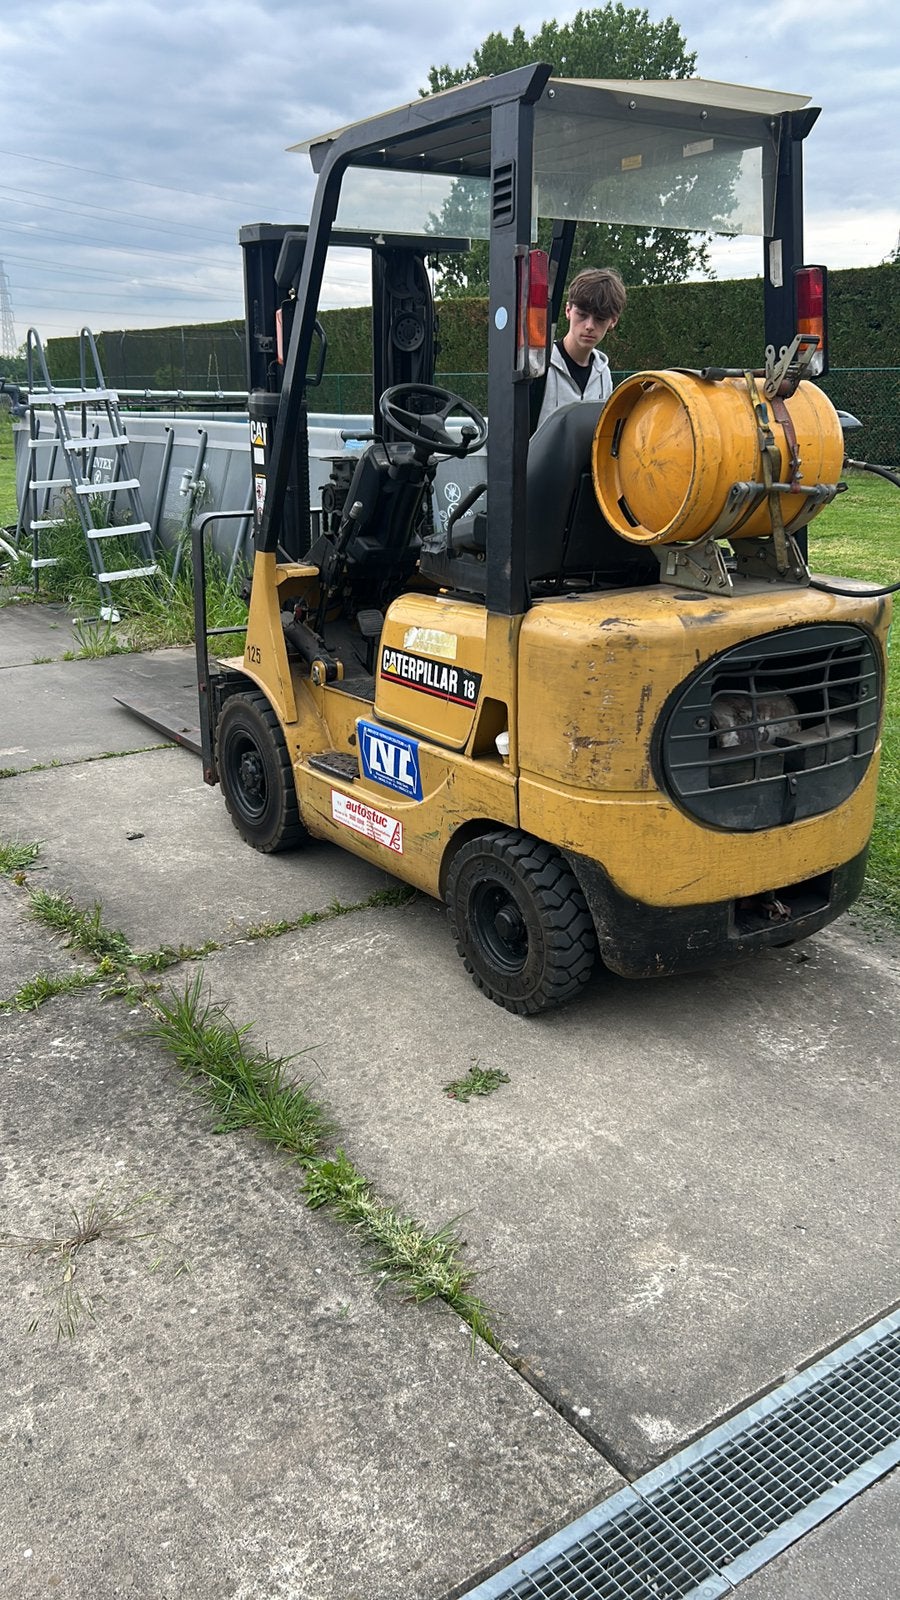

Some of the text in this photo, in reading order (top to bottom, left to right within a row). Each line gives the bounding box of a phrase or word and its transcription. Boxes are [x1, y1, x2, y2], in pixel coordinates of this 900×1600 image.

[250, 420, 268, 446] CAT
[247, 645, 261, 664] 125
[383, 649, 475, 700] CATERPILLAR 18
[345, 800, 388, 828] autostuc
